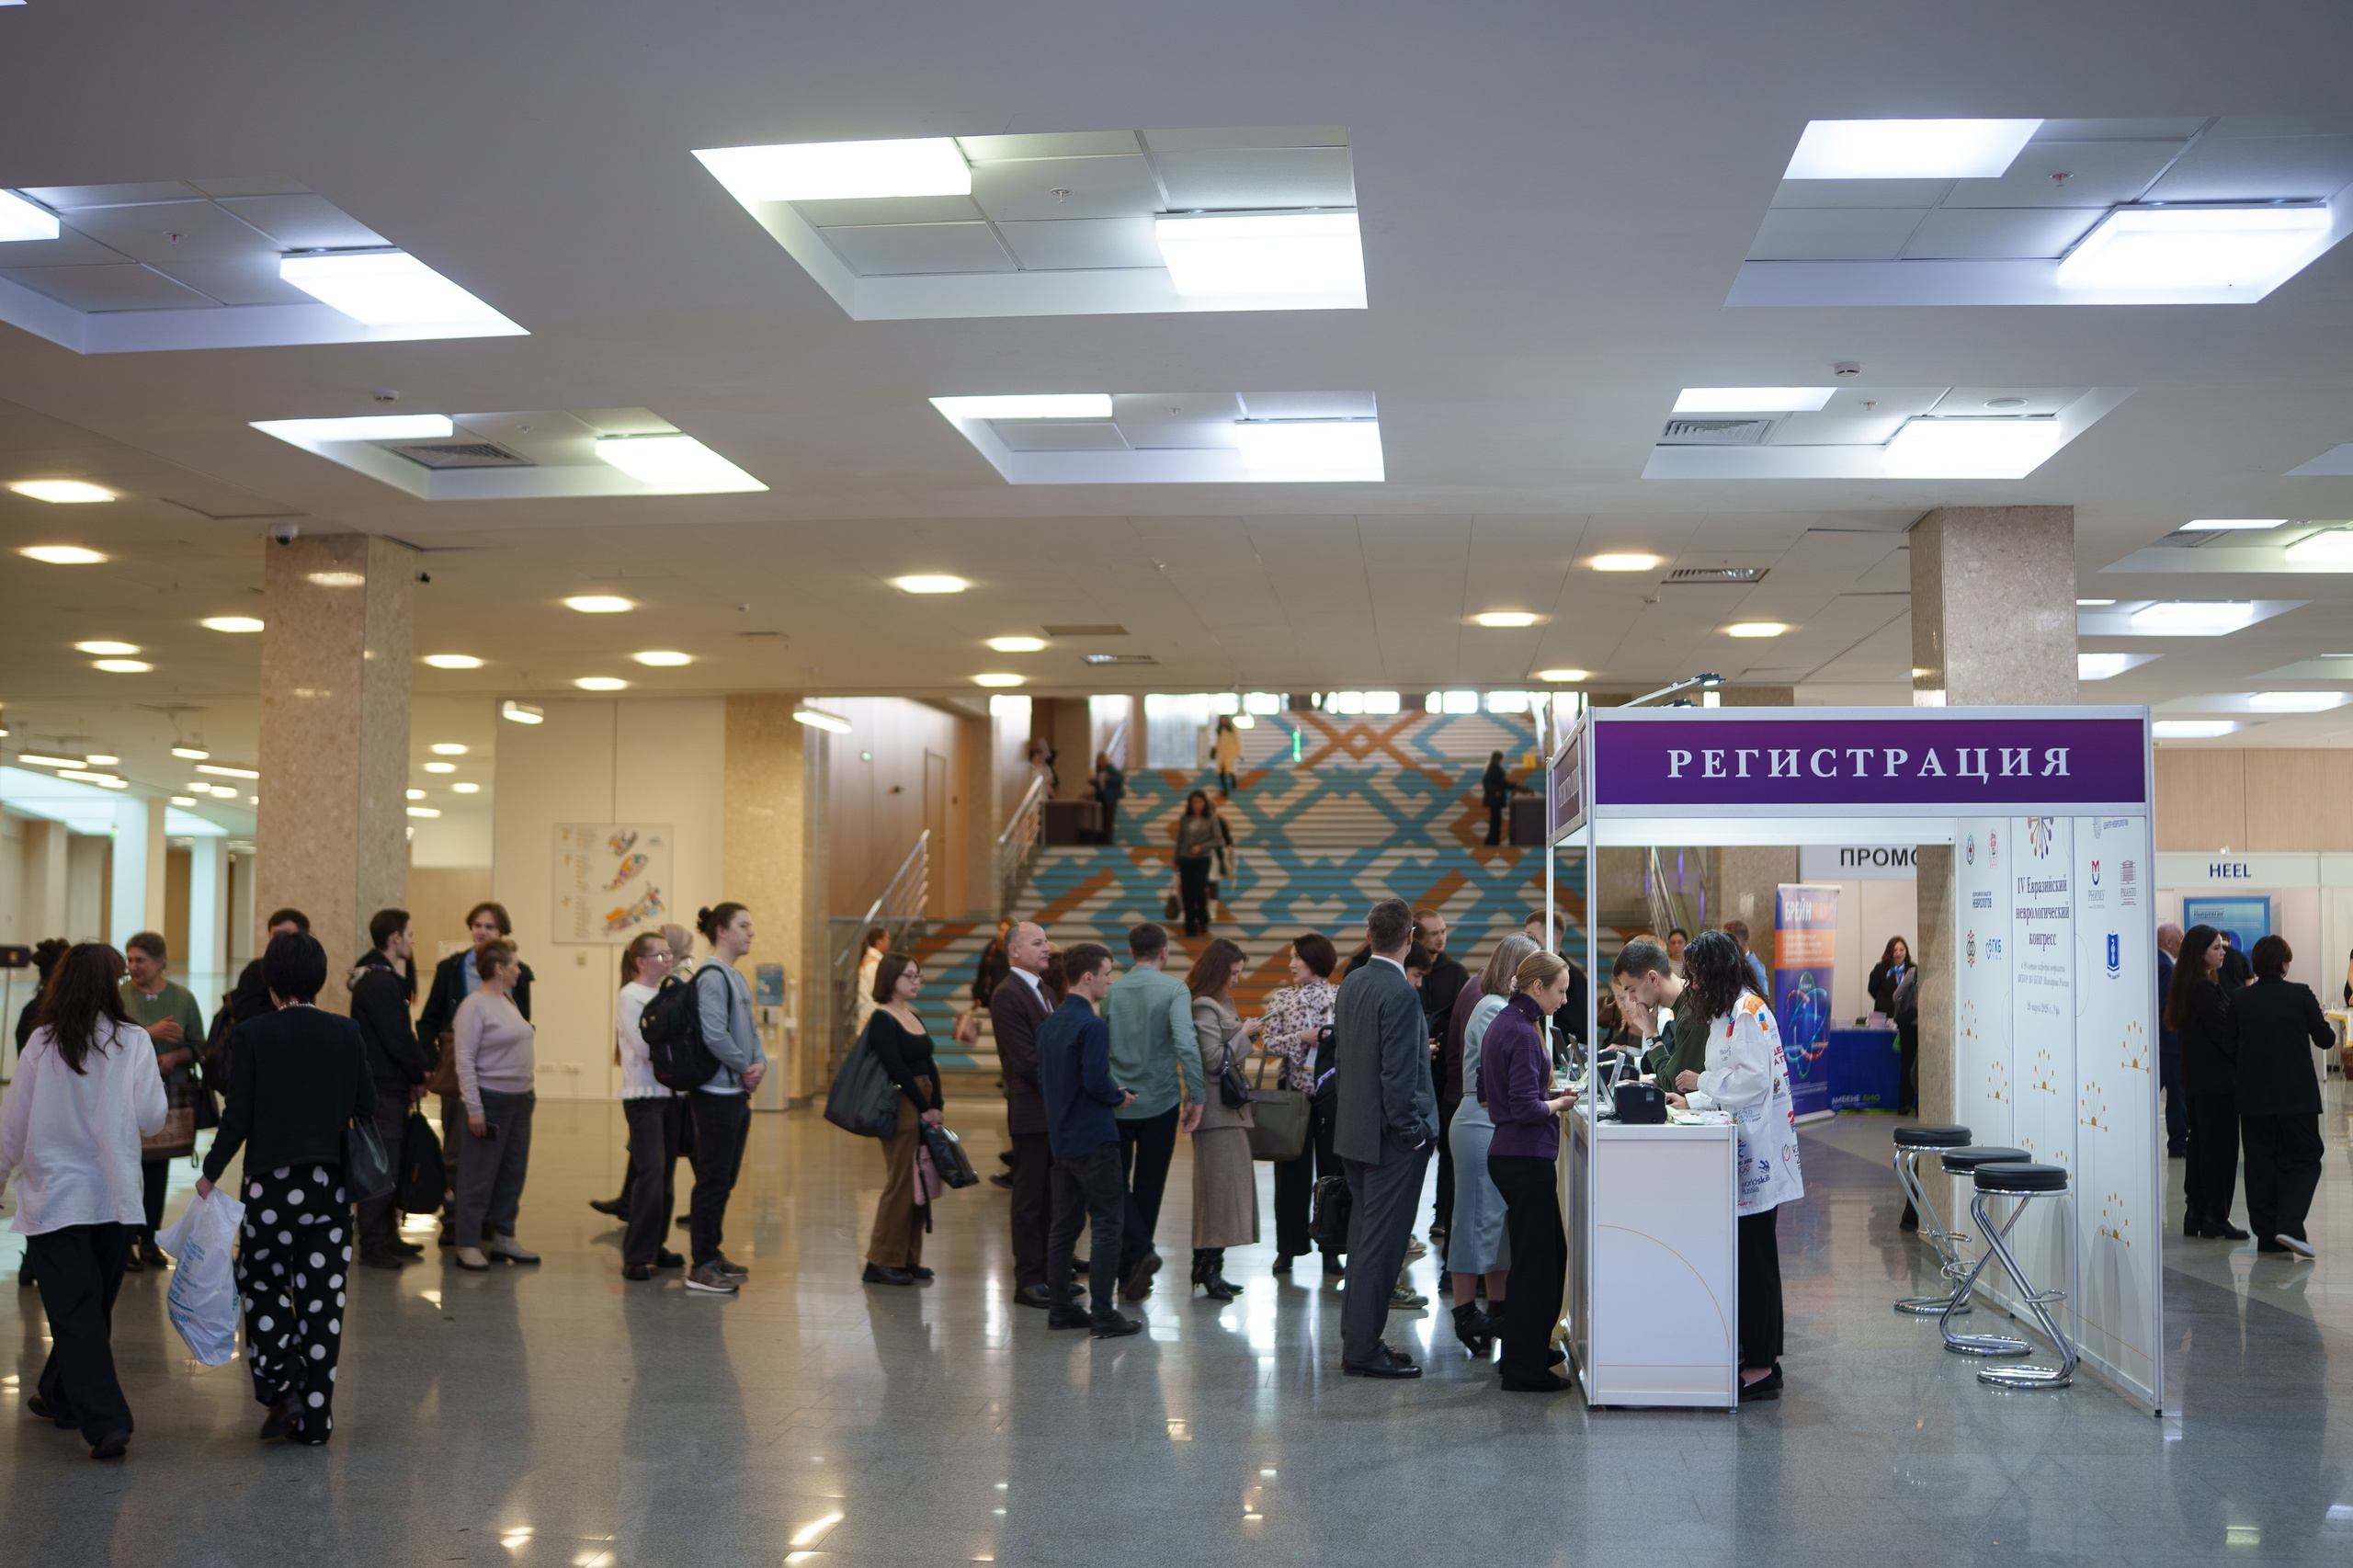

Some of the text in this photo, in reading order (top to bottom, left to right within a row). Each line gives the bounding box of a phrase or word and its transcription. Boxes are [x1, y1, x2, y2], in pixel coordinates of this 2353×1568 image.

[1666, 747, 2071, 785] РЕГИСТРАЦИЯ
[2210, 863, 2252, 878] HEEL
[2027, 874, 2067, 899] Евразийский
[2016, 902, 2070, 925] неврологический
[2029, 933, 2057, 951] конгресс
